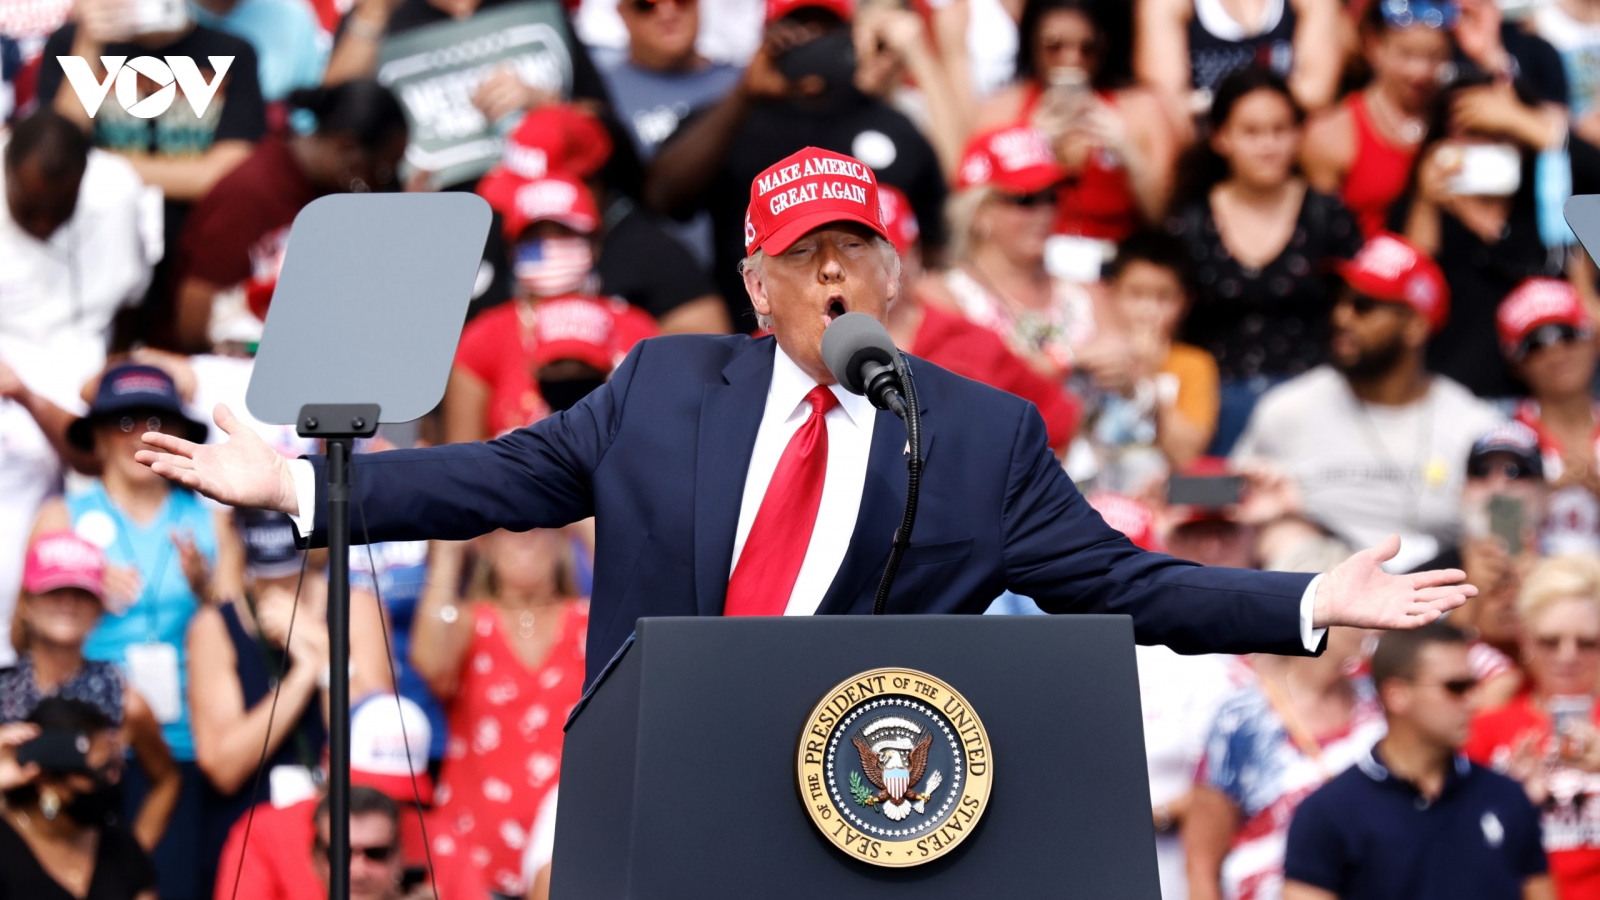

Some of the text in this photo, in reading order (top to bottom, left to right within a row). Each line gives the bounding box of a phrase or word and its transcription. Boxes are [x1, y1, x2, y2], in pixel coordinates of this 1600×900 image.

[757, 157, 872, 196] MAKE AMERICA
[769, 181, 867, 216] GREAT AGAIN
[804, 675, 987, 859] SEAL OF THE PRESIDENT OF THE UNITED STATES
